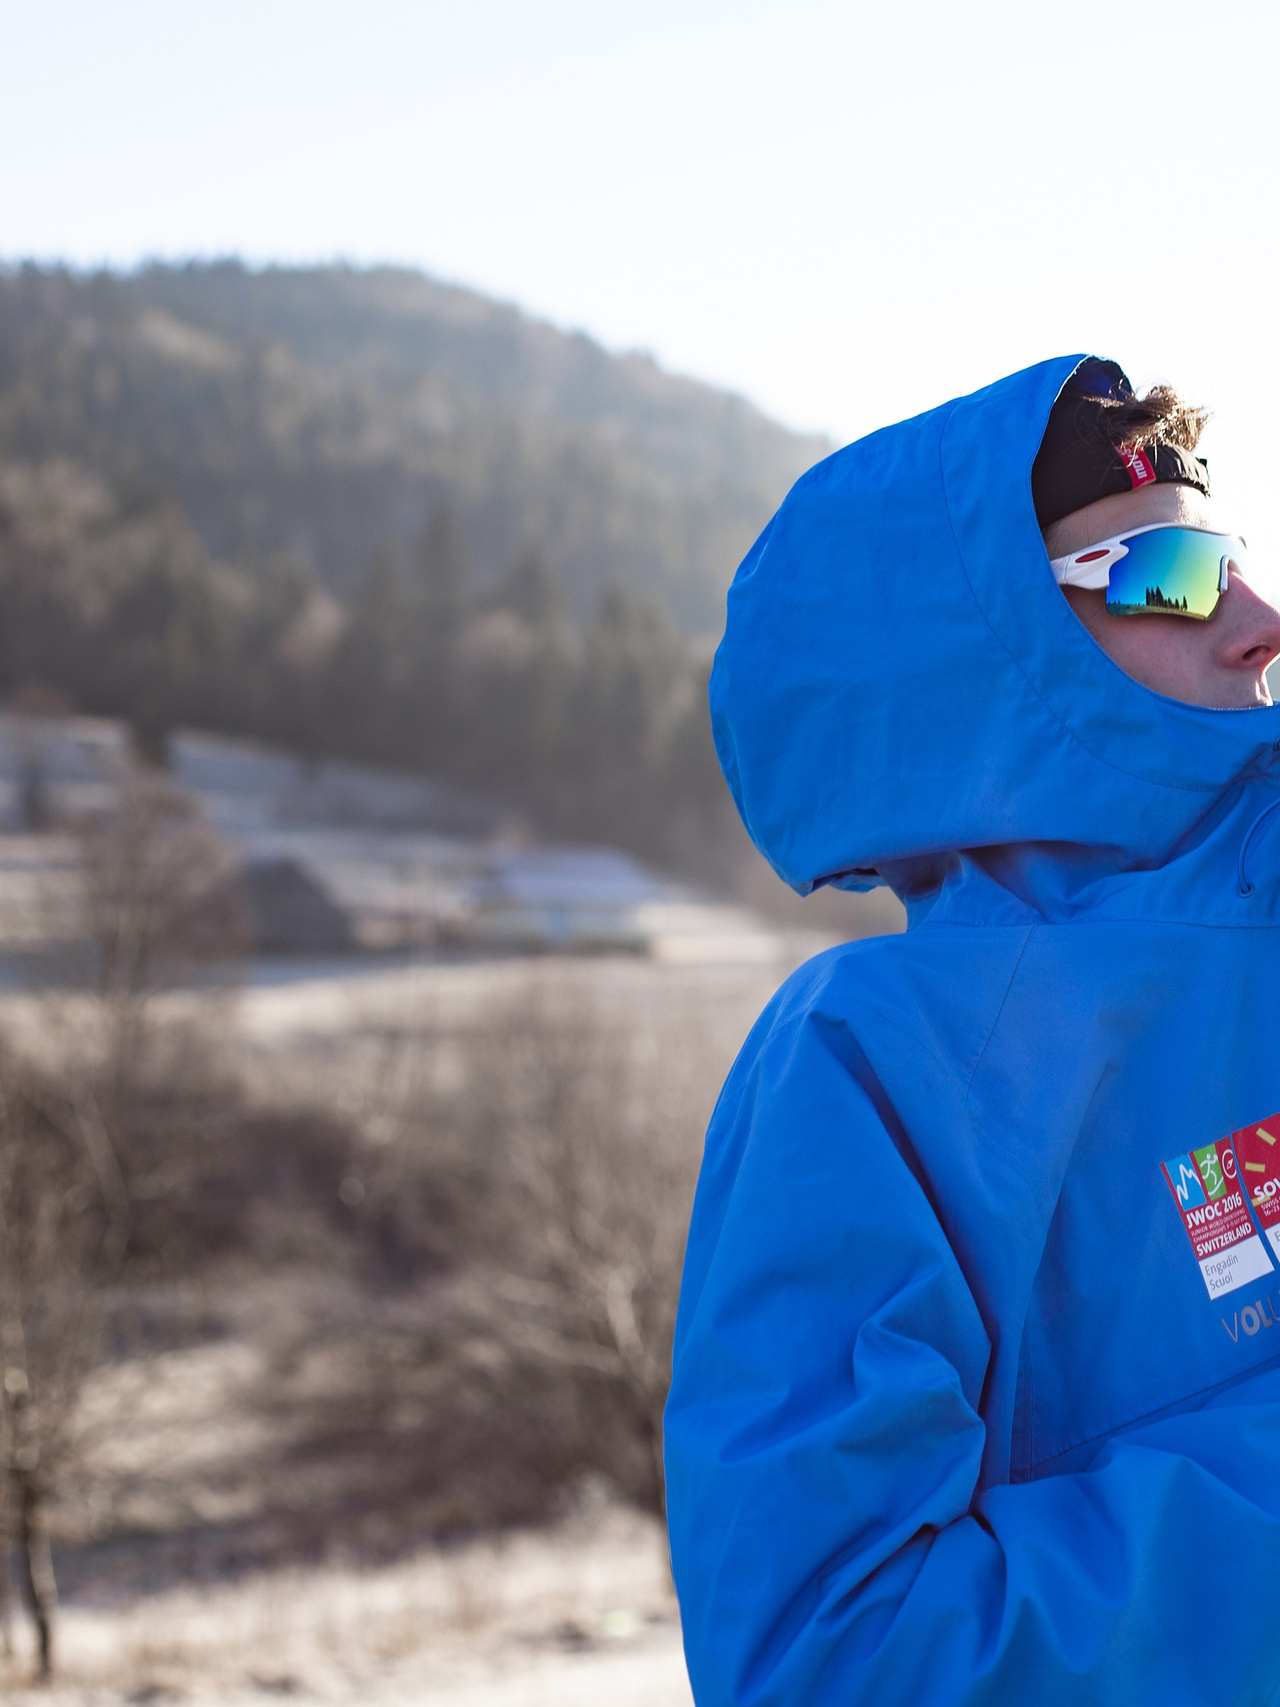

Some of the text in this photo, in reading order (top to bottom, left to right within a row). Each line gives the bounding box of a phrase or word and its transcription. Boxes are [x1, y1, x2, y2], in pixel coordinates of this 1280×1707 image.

[1186, 1191, 1242, 1229] JWOC 2016
[1260, 1197, 1279, 1211] SWISS
[1196, 1222, 1252, 1257] SWITZERLAND
[1204, 1254, 1239, 1276] Engadin
[1209, 1270, 1233, 1291] Scuol
